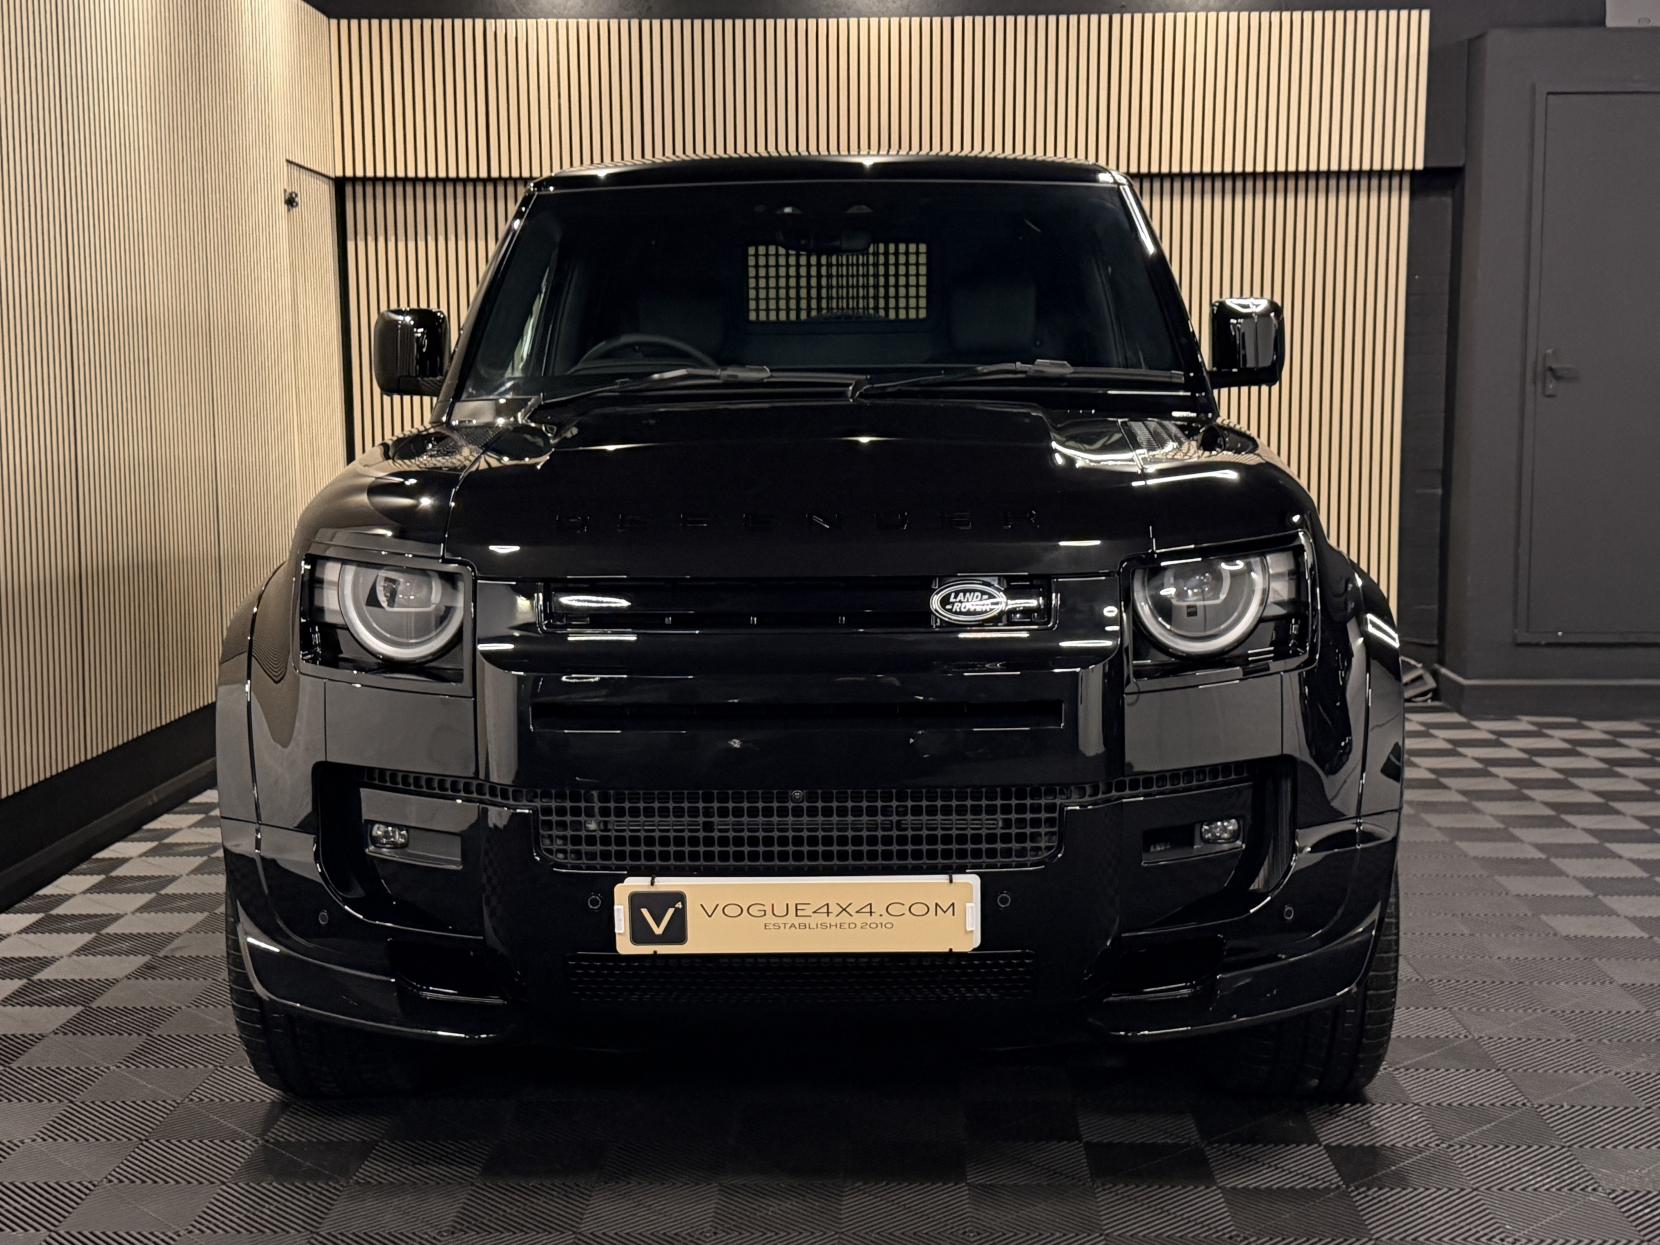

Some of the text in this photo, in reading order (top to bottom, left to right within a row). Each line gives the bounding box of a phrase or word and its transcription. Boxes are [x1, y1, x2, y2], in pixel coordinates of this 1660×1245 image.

[950, 591, 982, 603] LAND
[700, 901, 956, 918] VOGUE4X4.COM
[763, 921, 894, 930] ESTABLISHED 2010
